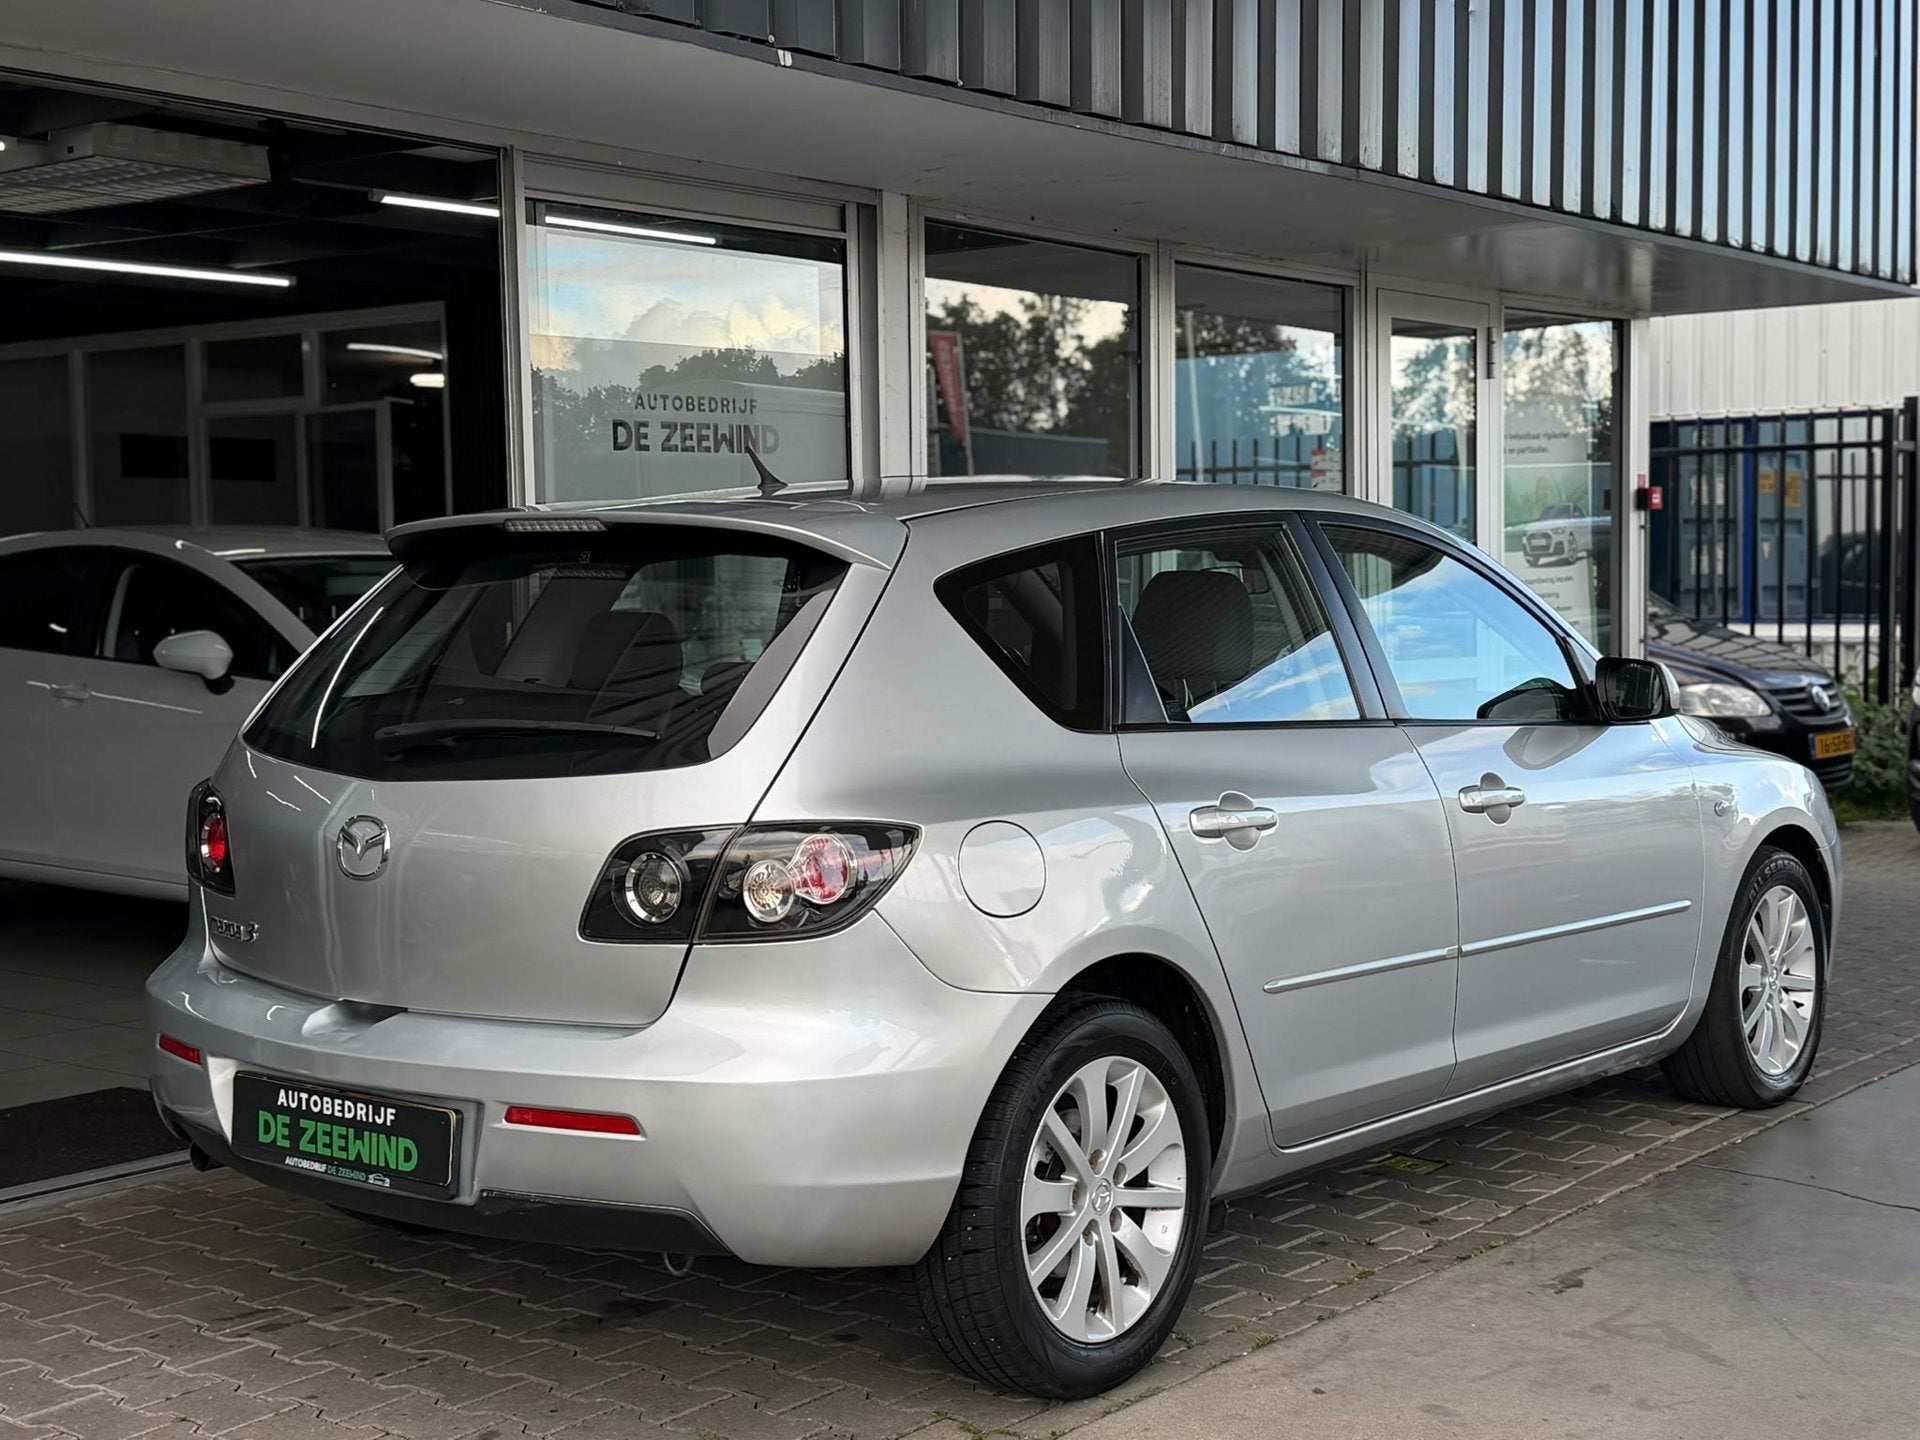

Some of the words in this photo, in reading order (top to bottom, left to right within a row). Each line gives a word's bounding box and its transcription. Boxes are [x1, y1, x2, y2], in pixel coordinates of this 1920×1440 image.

[634, 393, 758, 415] AUTOBEDRIJF
[611, 419, 651, 452] DE
[660, 421, 780, 454] ZEEWIND
[277, 1088, 397, 1127] AUTOBEDRIJF
[258, 1110, 291, 1148] DE
[299, 1118, 418, 1172] ZEEWIND
[284, 1155, 327, 1173] AUTOBEDRIJF
[327, 1164, 337, 1175] DE
